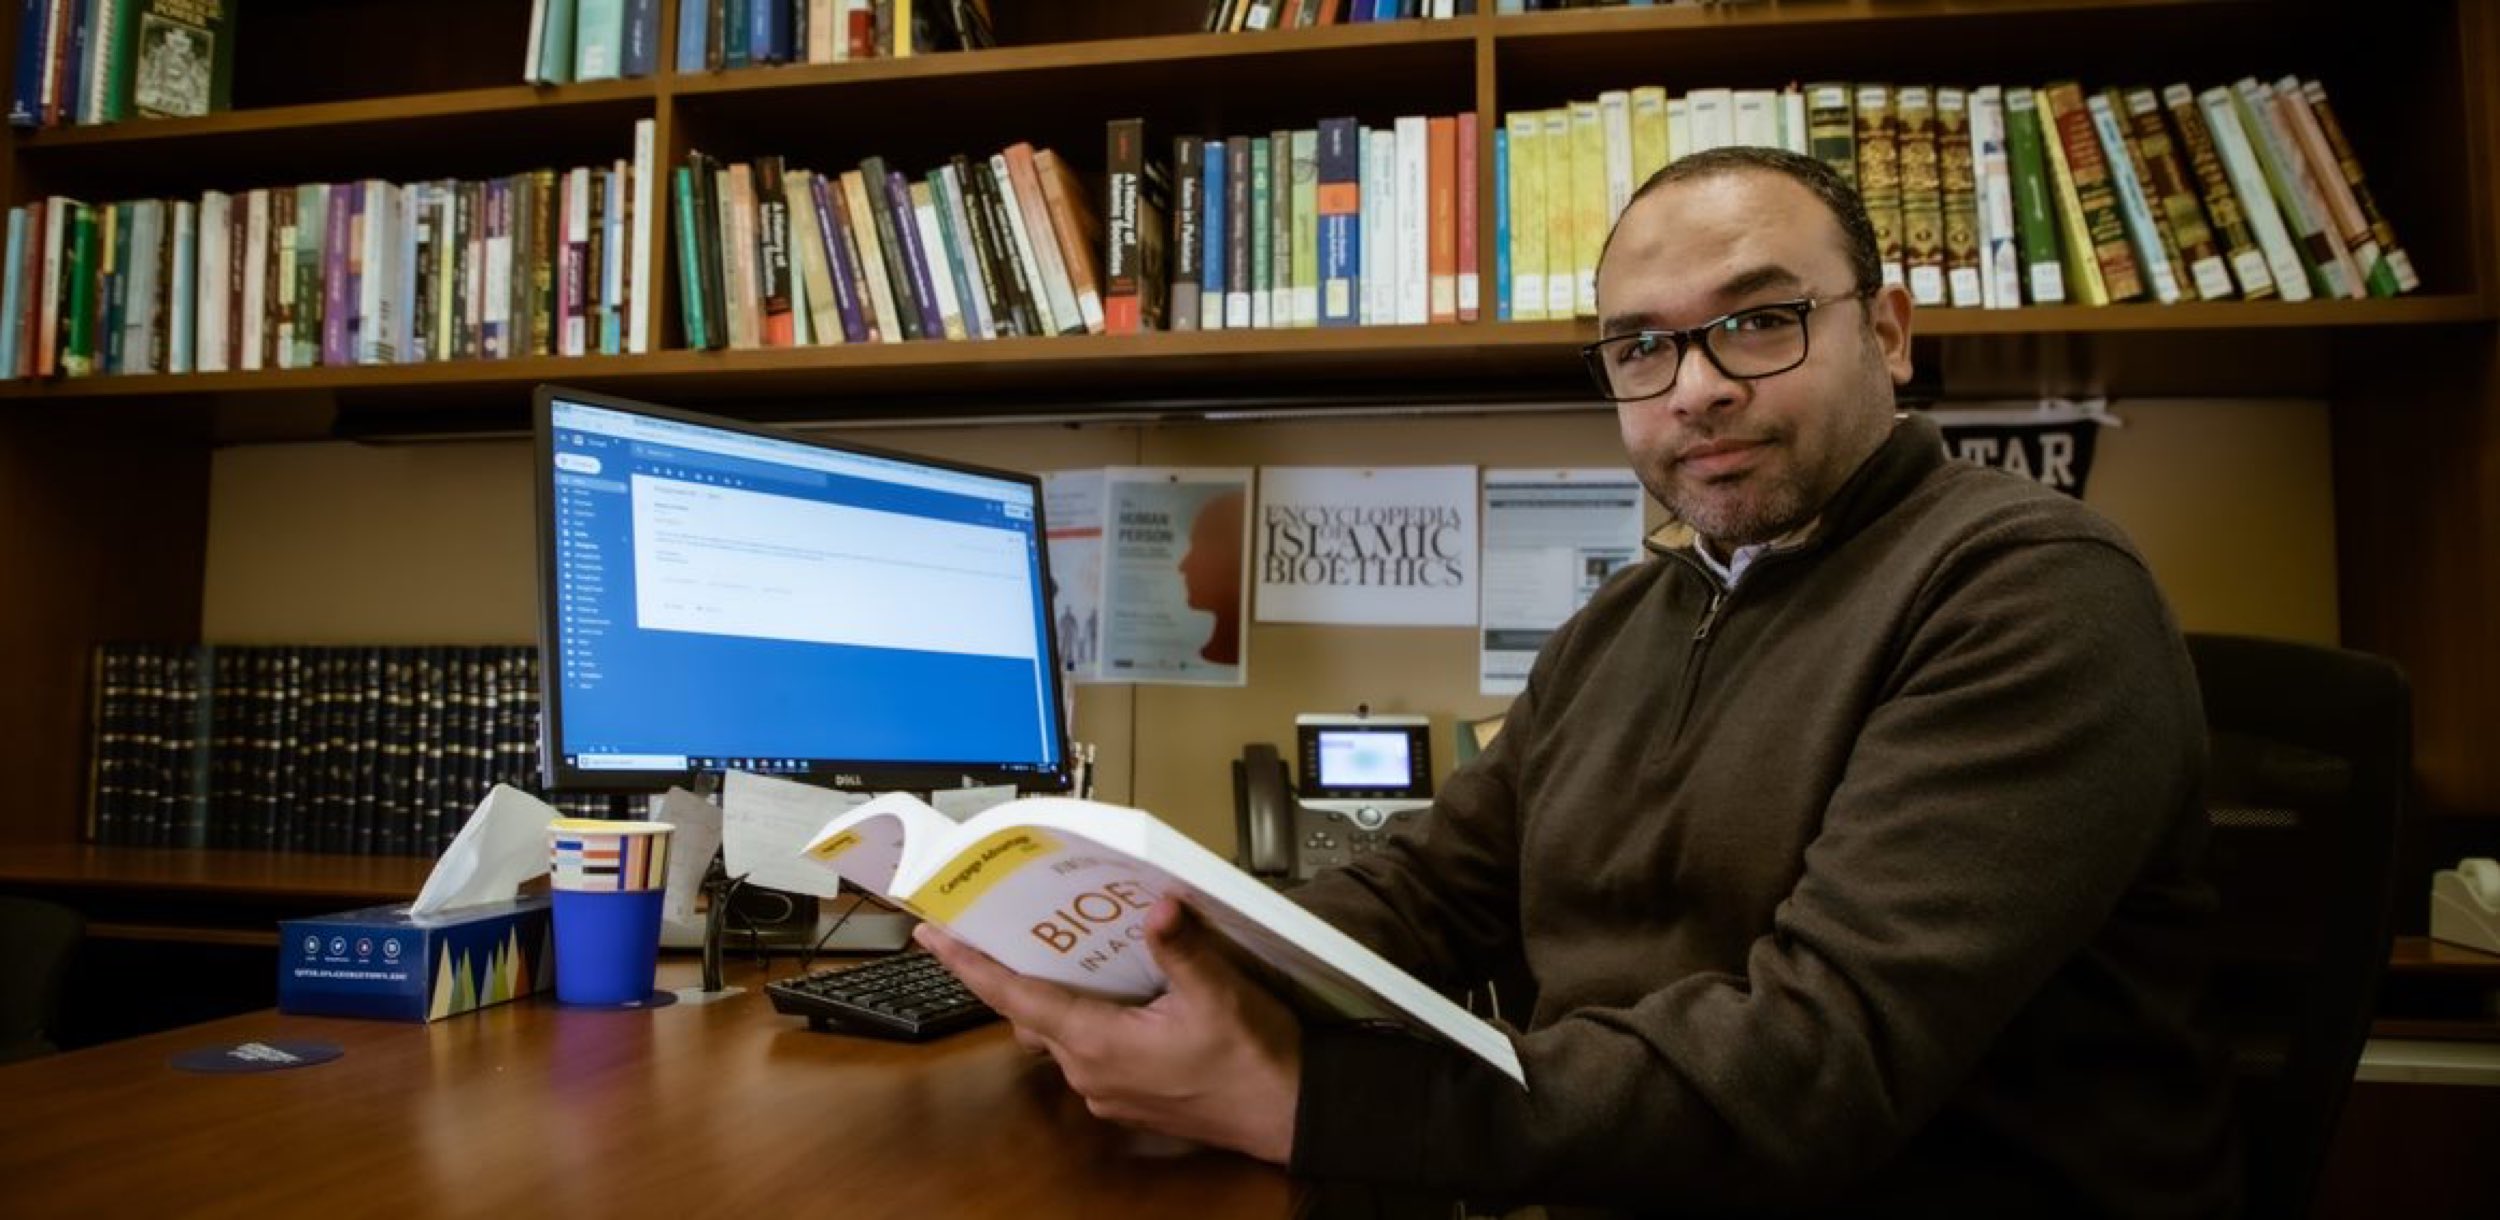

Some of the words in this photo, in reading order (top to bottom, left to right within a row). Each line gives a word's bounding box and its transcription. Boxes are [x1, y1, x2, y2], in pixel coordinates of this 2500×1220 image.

[1121, 184, 1137, 229] History
[1265, 506, 1462, 530] ENCYCLOPEDIA
[1267, 524, 1463, 559] ISLAMIC
[1264, 557, 1464, 586] BIOETHICS
[834, 774, 862, 786] DELL
[1078, 948, 1108, 973] IN
[1108, 938, 1128, 955] A
